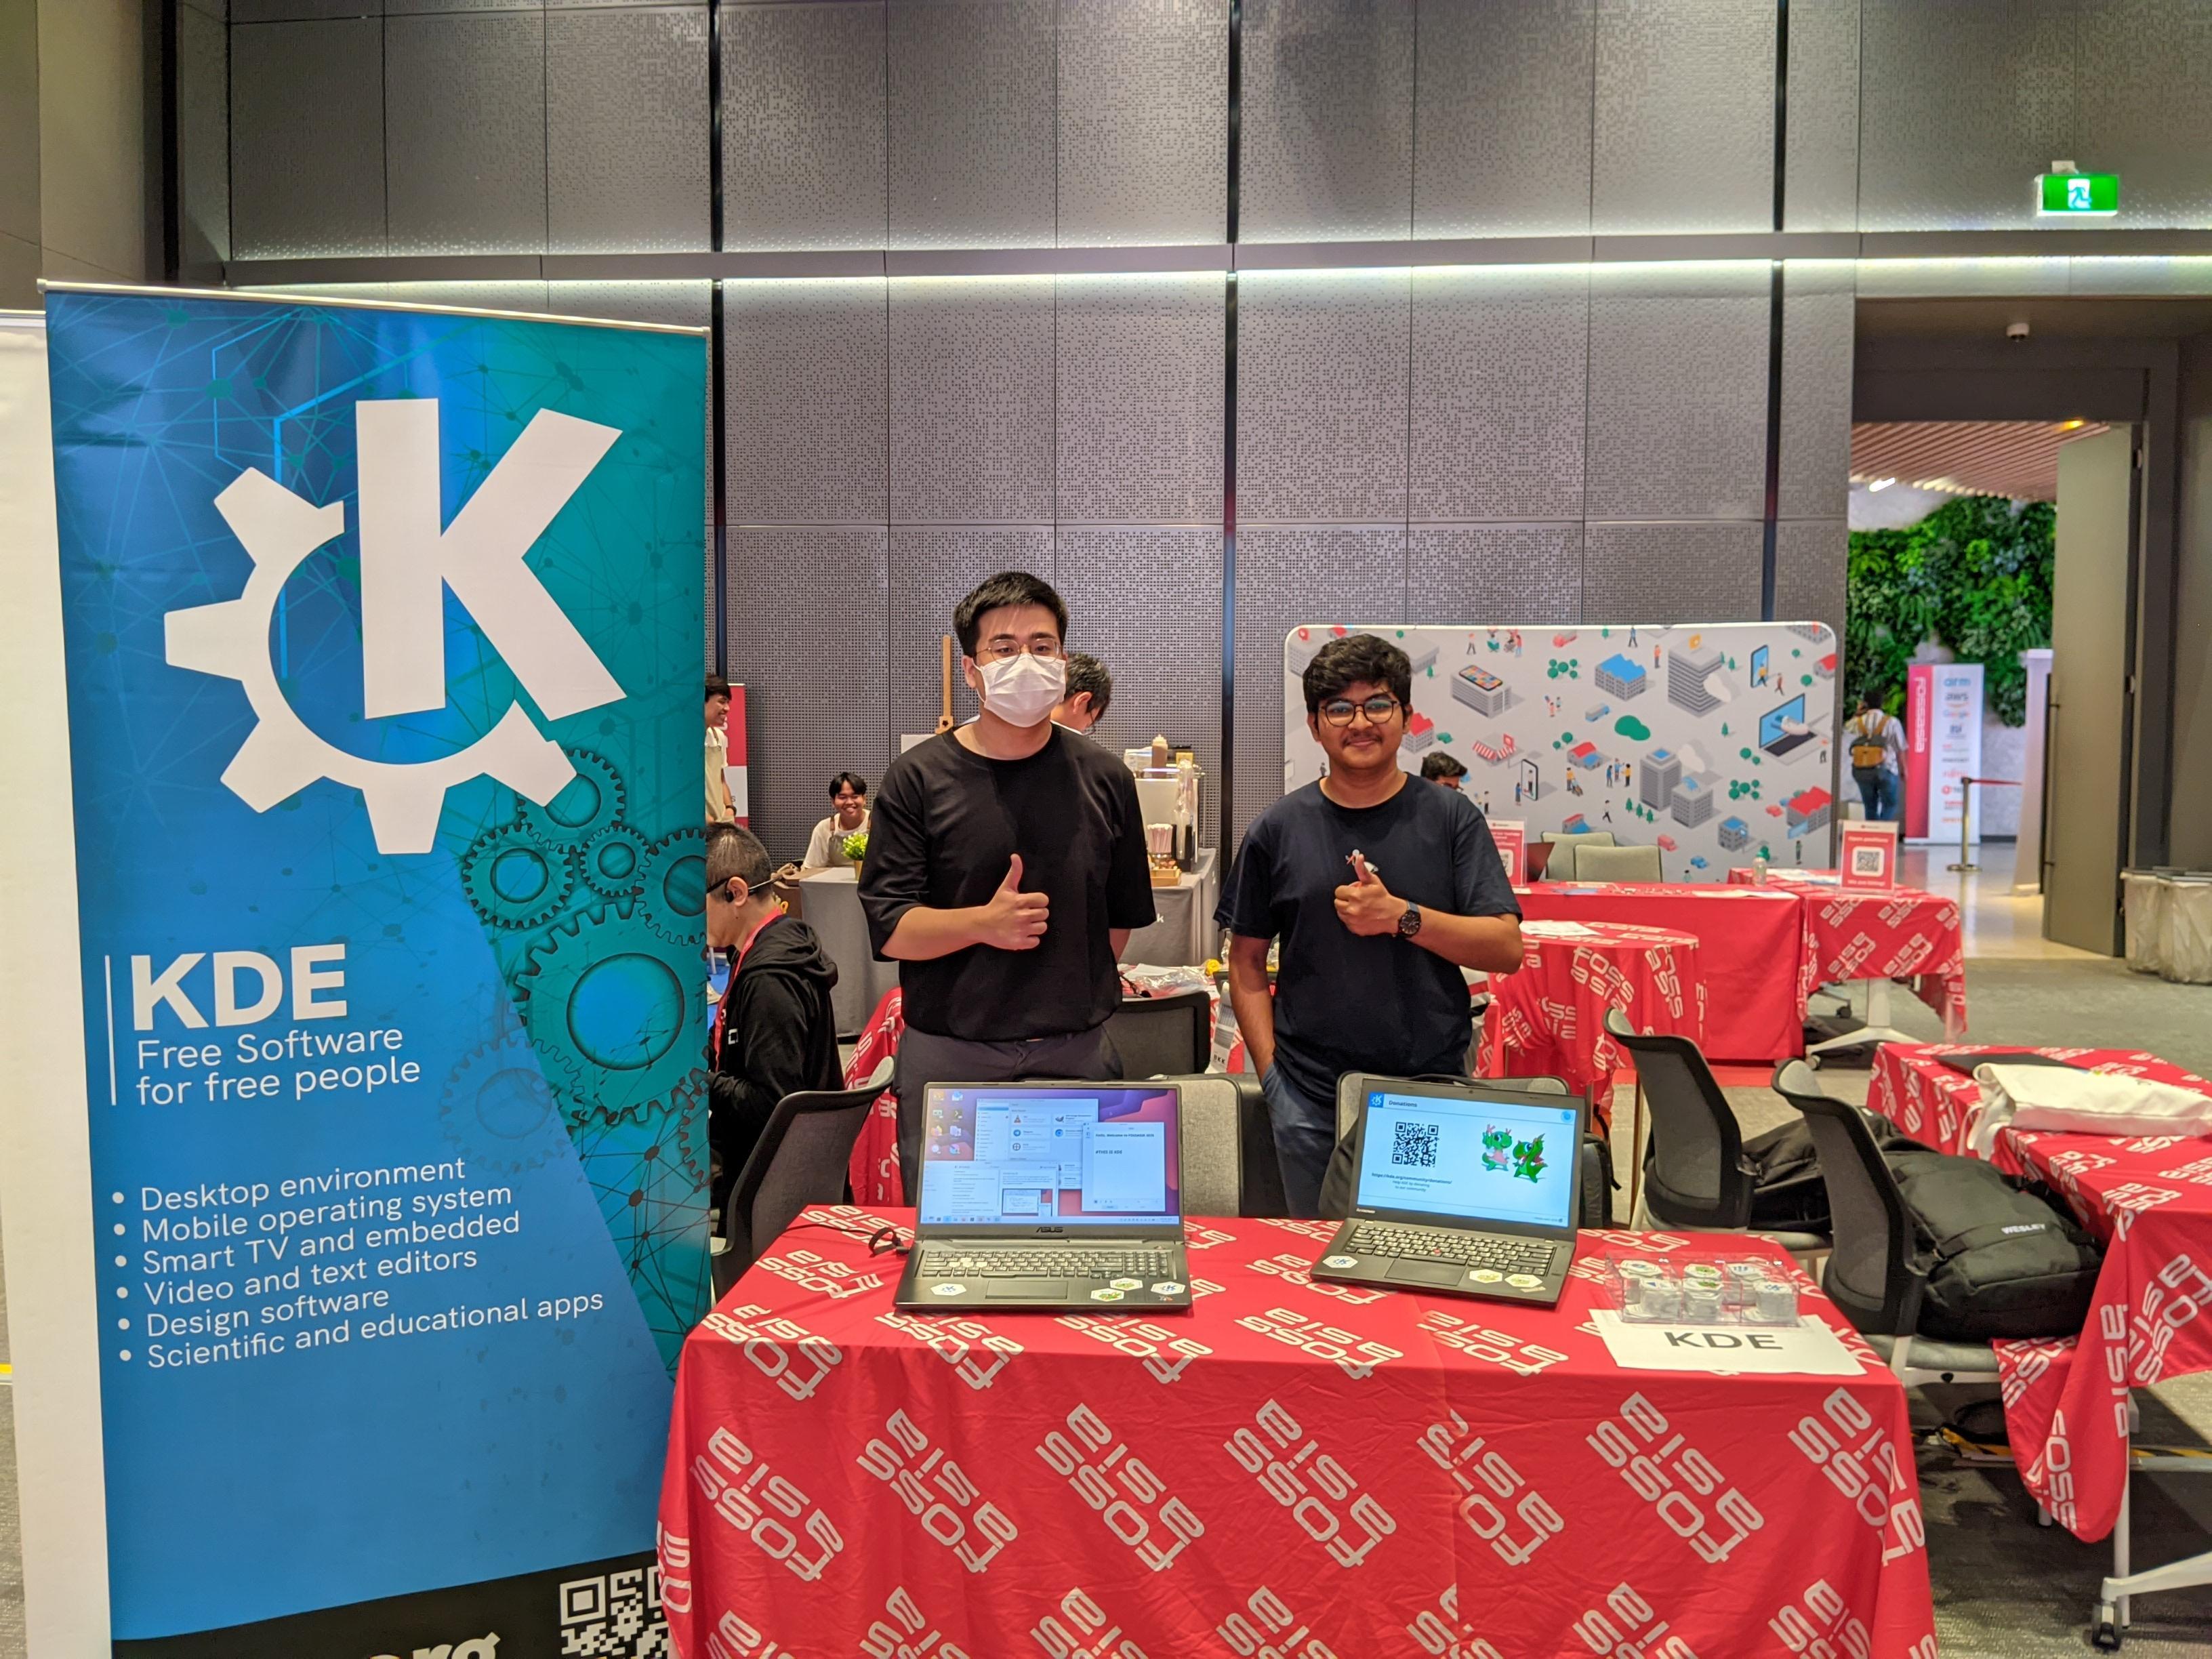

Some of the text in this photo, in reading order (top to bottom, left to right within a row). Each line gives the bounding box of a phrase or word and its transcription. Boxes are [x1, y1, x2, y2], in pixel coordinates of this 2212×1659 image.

[131, 943, 347, 1031] KDE
[1572, 945, 1635, 1004] foss
[136, 1056, 420, 1105] for free people
[138, 1028, 403, 1069] Free Software
[141, 1158, 466, 1211] Desktop environment
[143, 1187, 512, 1243] Mobile operating system
[143, 1210, 520, 1275] Smart TV and embedded
[2001, 1223, 2046, 1235] WESLEY
[144, 1250, 478, 1305] Video and text editors
[147, 1289, 390, 1337] Design software
[148, 1292, 604, 1369] Scientific and educational apps
[700, 1313, 827, 1401] foss
[874, 1312, 1006, 1391] foss
[1053, 1314, 1194, 1385] foss
[1233, 1315, 1389, 1380] foss
[1264, 1307, 1405, 1363] asia
[1664, 1331, 1784, 1350] KDE
[708, 1426, 844, 1558] asia
[885, 1408, 1019, 1549] asia
[1034, 1431, 1187, 1572] foss
[1065, 1402, 1206, 1546] asia
[1223, 1427, 1378, 1568] foss
[1255, 1398, 1397, 1542] asia
[1585, 1420, 1743, 1563] foss
[1620, 1391, 1764, 1539] asia
[690, 1454, 832, 1582] foss
[855, 1438, 1001, 1574] foss
